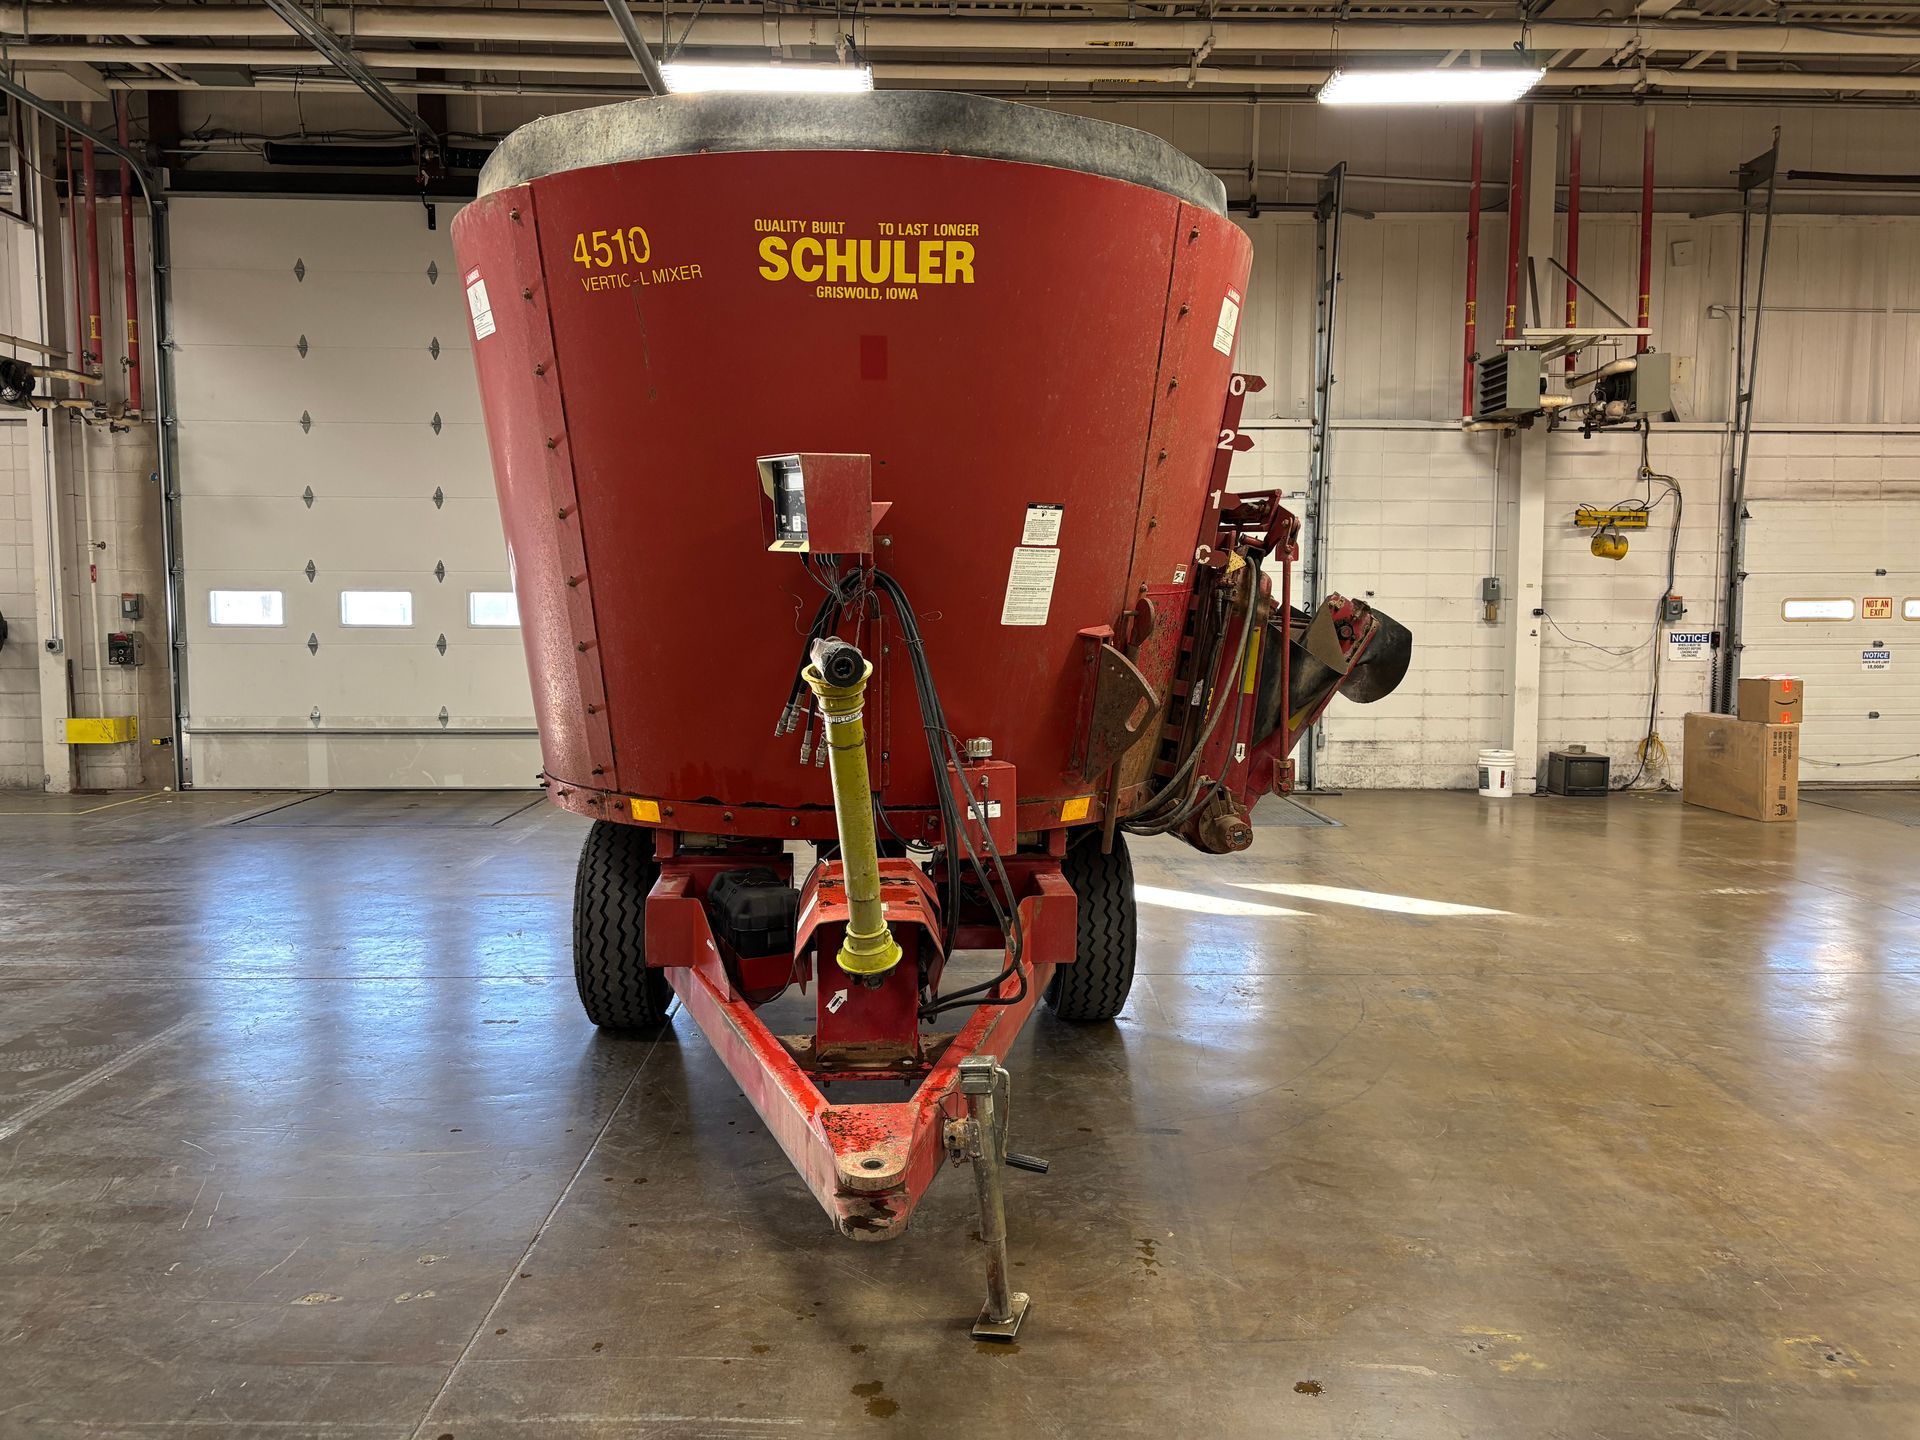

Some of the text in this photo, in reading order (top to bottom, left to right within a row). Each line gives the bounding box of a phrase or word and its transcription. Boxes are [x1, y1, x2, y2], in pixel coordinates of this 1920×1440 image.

[754, 218, 845, 234] QUALITY BUILT
[878, 222, 979, 236] TO LAST LONGER
[573, 226, 651, 269] 4510
[758, 236, 975, 284] SCHULER
[652, 264, 703, 284] MIXER
[816, 286, 919, 300] GRISWOLD, IOWA
[1218, 428, 1236, 450] 2
[1210, 489, 1222, 510] 1
[1304, 602, 1310, 614] 2
[1866, 600, 1889, 608] NOT AN
[1870, 608, 1884, 616] EXIT
[1672, 634, 1708, 642] NOTICE
